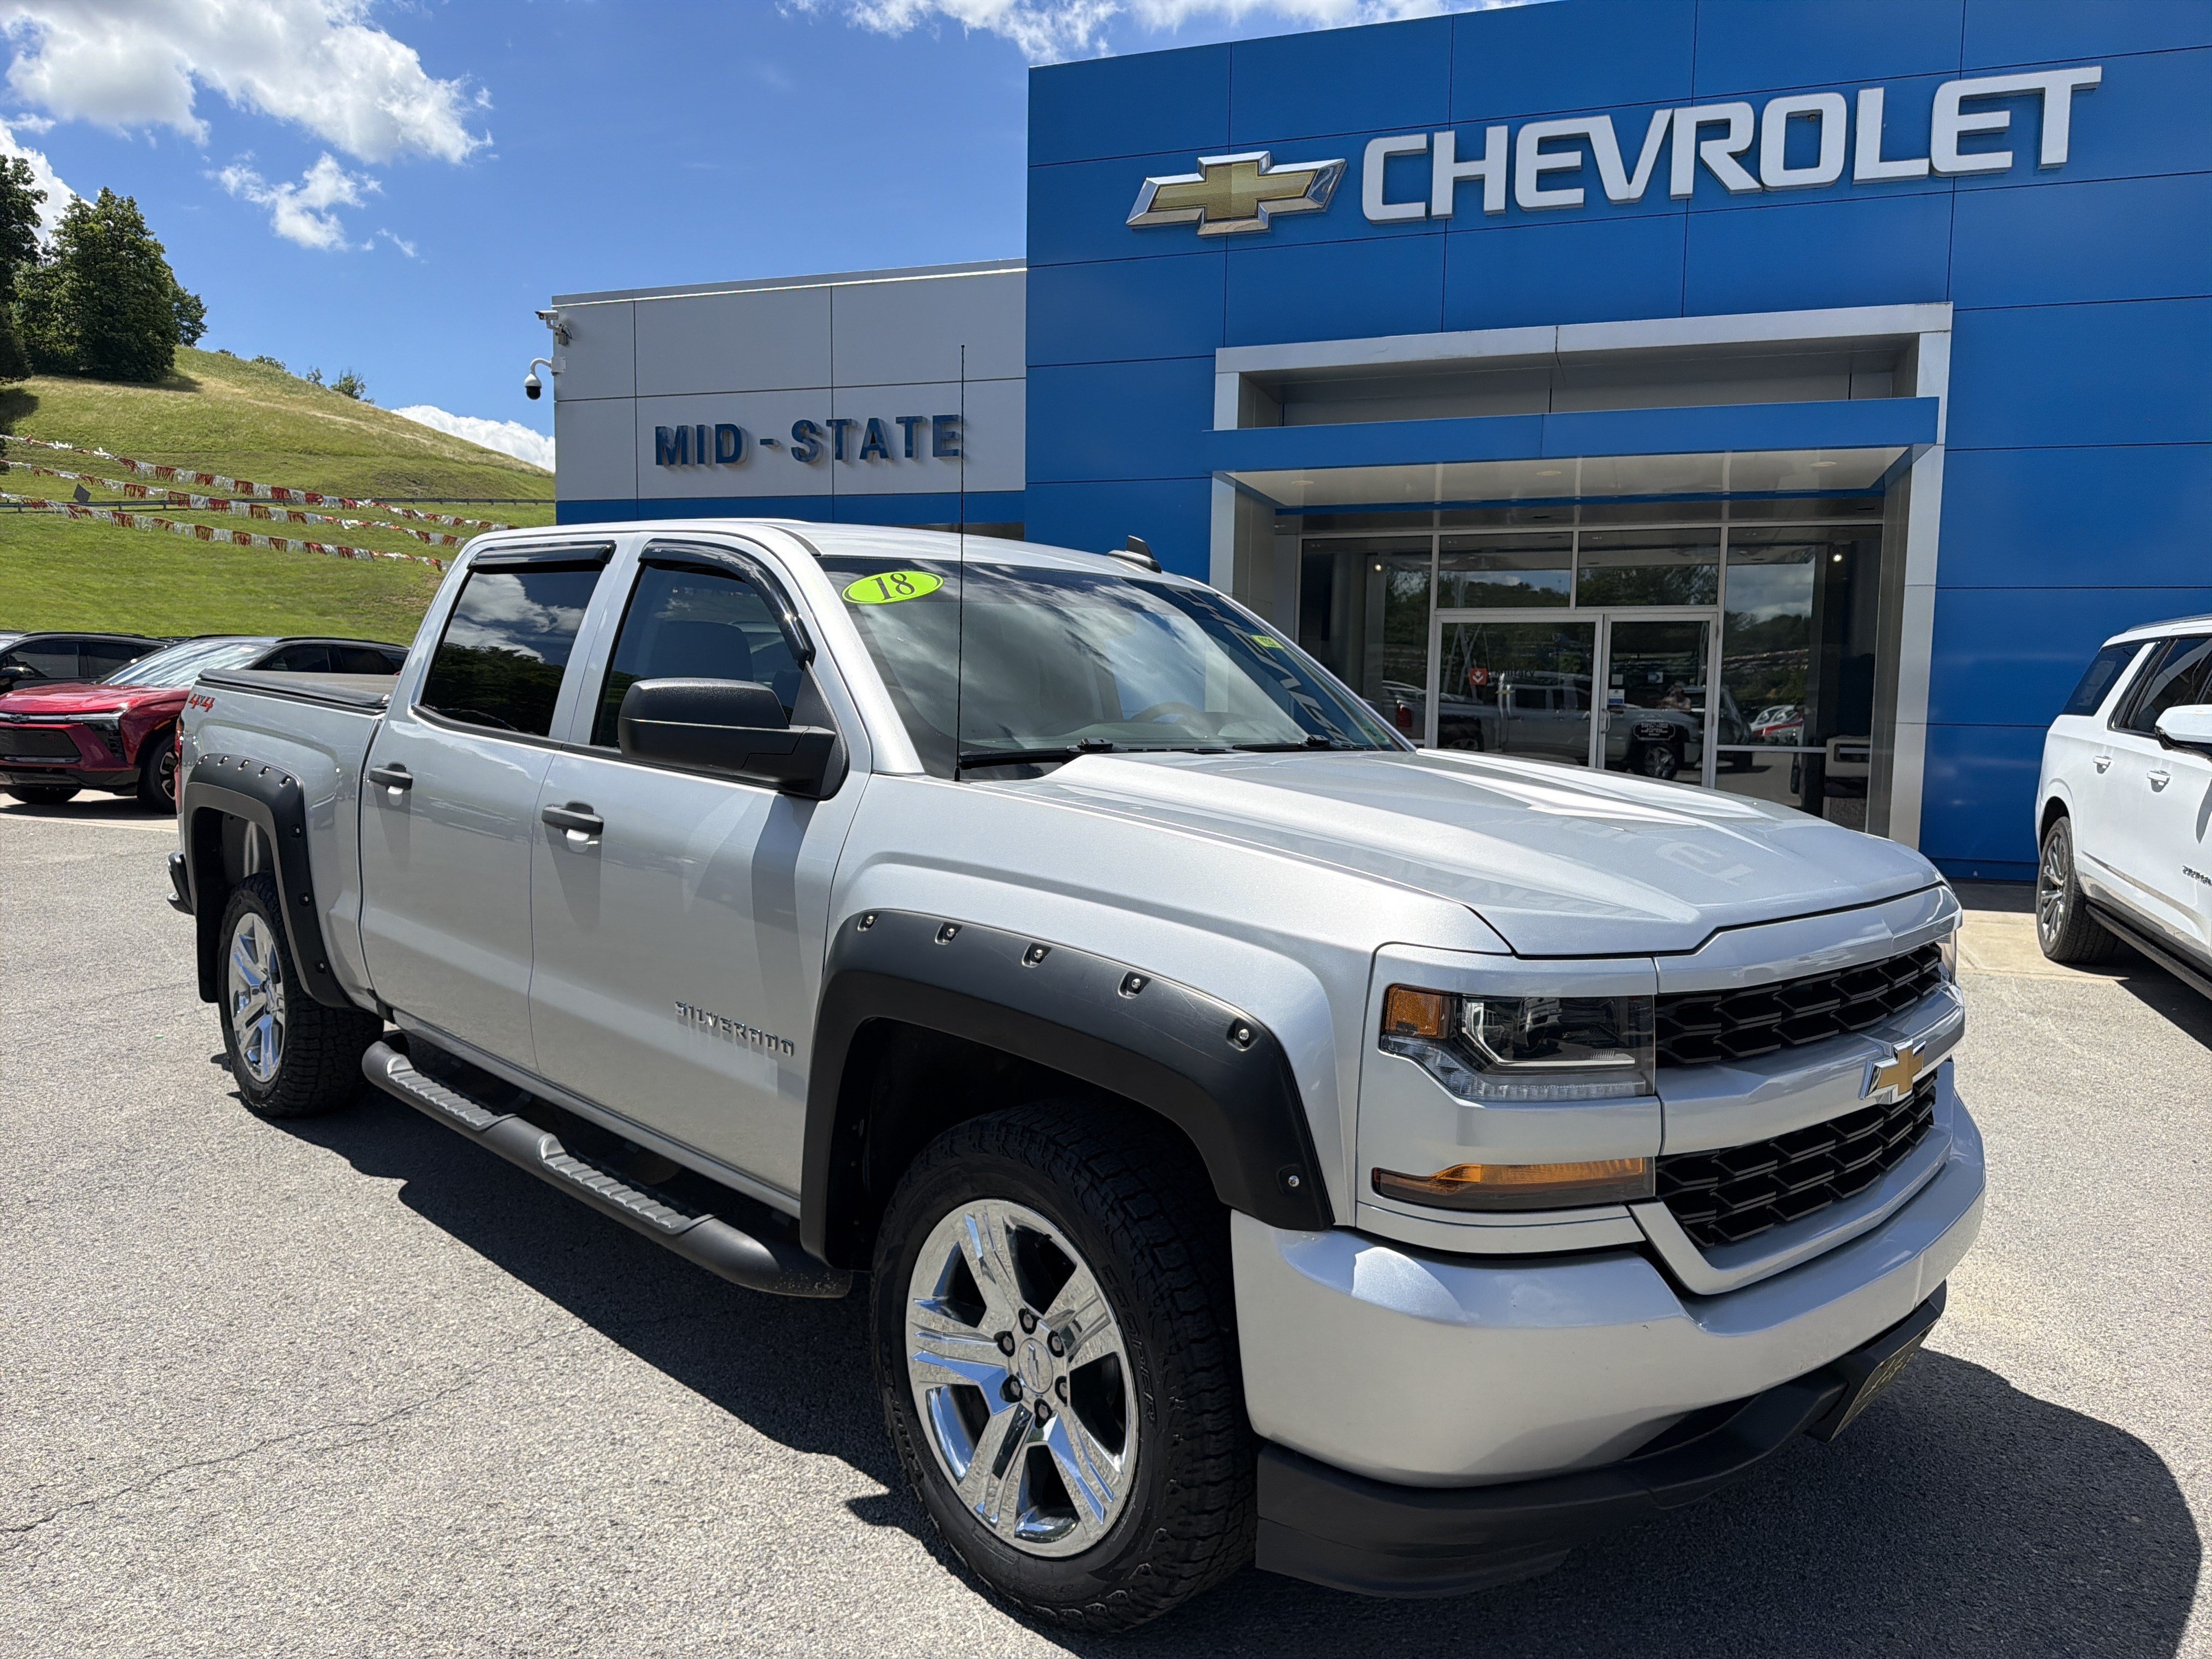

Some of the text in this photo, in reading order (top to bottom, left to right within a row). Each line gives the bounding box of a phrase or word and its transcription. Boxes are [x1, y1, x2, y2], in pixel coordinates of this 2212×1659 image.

[1361, 65, 2102, 224] CHEVROLET
[655, 414, 963, 466] MID-STATE
[870, 573, 916, 601] 18
[675, 1000, 794, 1058] SILVERADO
